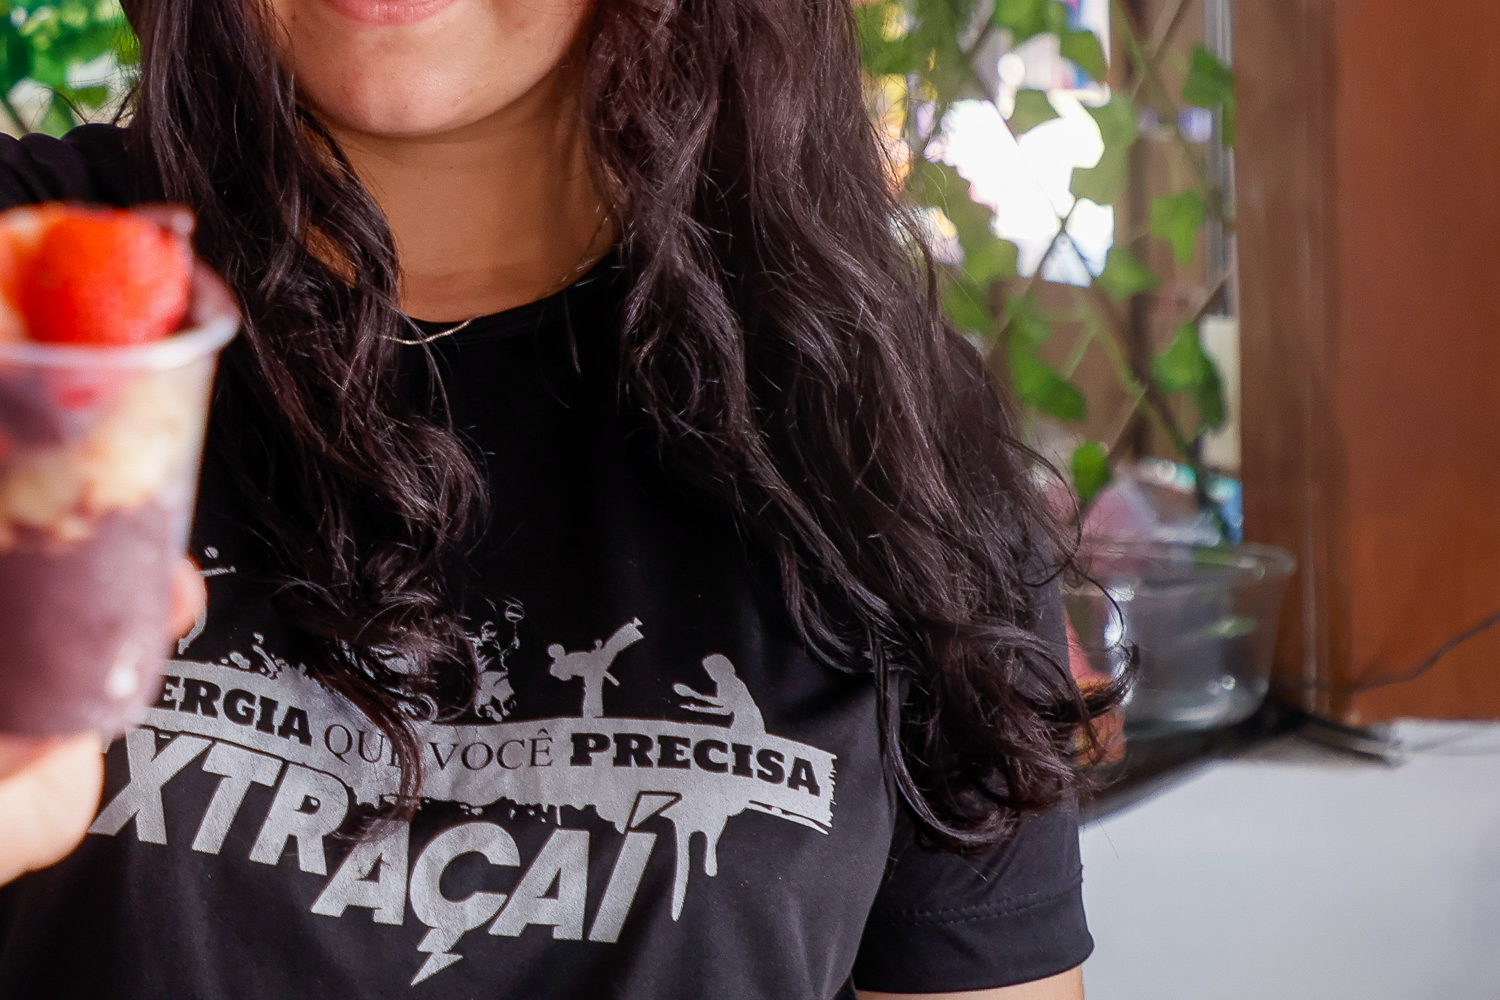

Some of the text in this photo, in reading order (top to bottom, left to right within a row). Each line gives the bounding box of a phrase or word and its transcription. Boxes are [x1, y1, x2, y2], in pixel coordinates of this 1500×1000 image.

[151, 673, 312, 746] ERGIA
[427, 728, 554, 771] VOCÊ
[570, 732, 821, 797] PRECISA
[87, 726, 682, 987] XTRAÇAÍ
